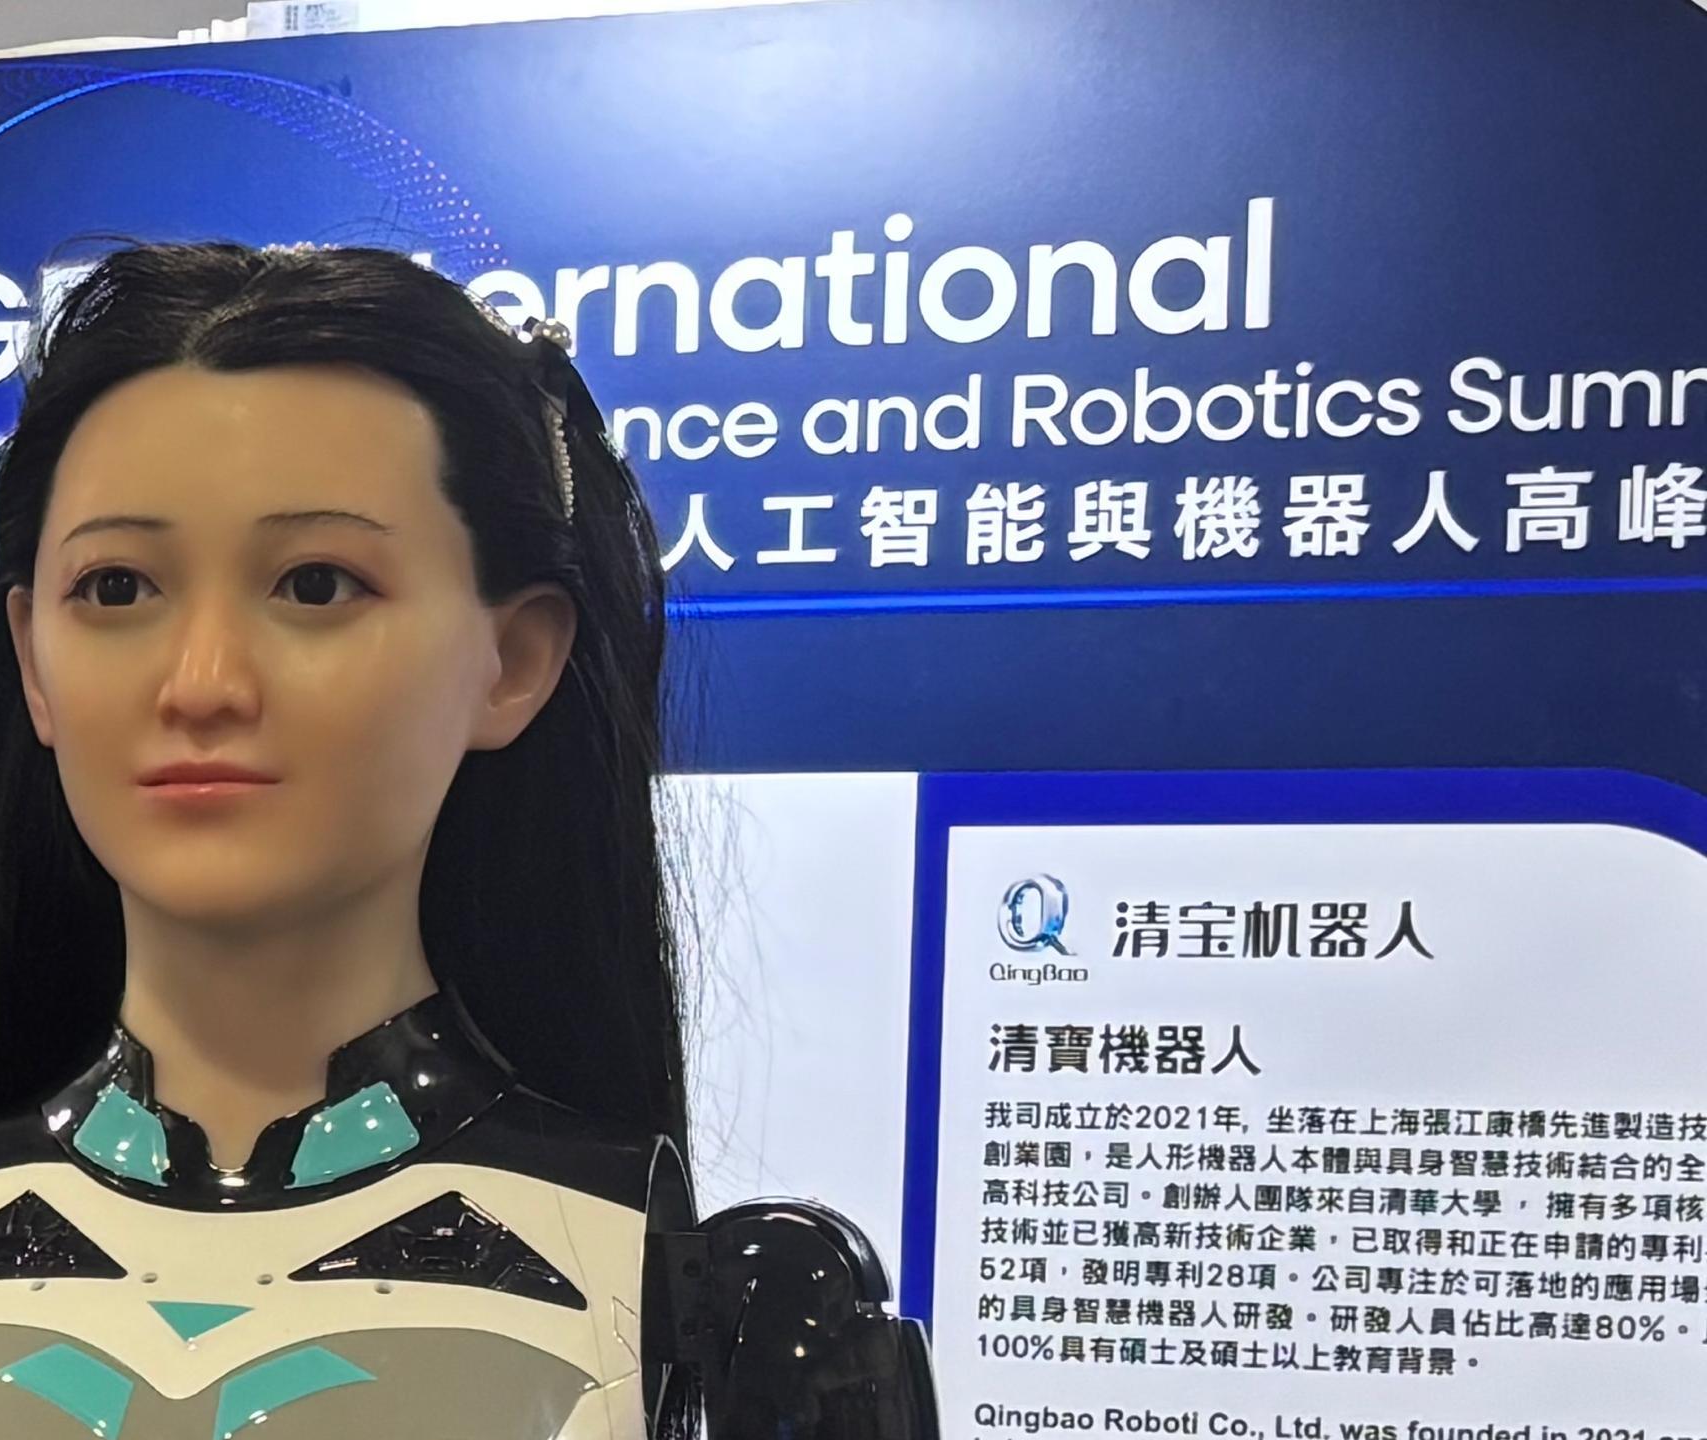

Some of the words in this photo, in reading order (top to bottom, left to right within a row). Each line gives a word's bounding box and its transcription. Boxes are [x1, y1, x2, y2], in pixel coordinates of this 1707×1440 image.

[411, 197, 1274, 358] ernational
[800, 373, 984, 456] and
[1011, 361, 1422, 448] Robotics
[1111, 900, 1435, 960] 清宝机器人
[987, 1022, 1263, 1077] 清寶機器人
[974, 1402, 1095, 1435] Qingbao
[1275, 1414, 1331, 1440] Ltd.
